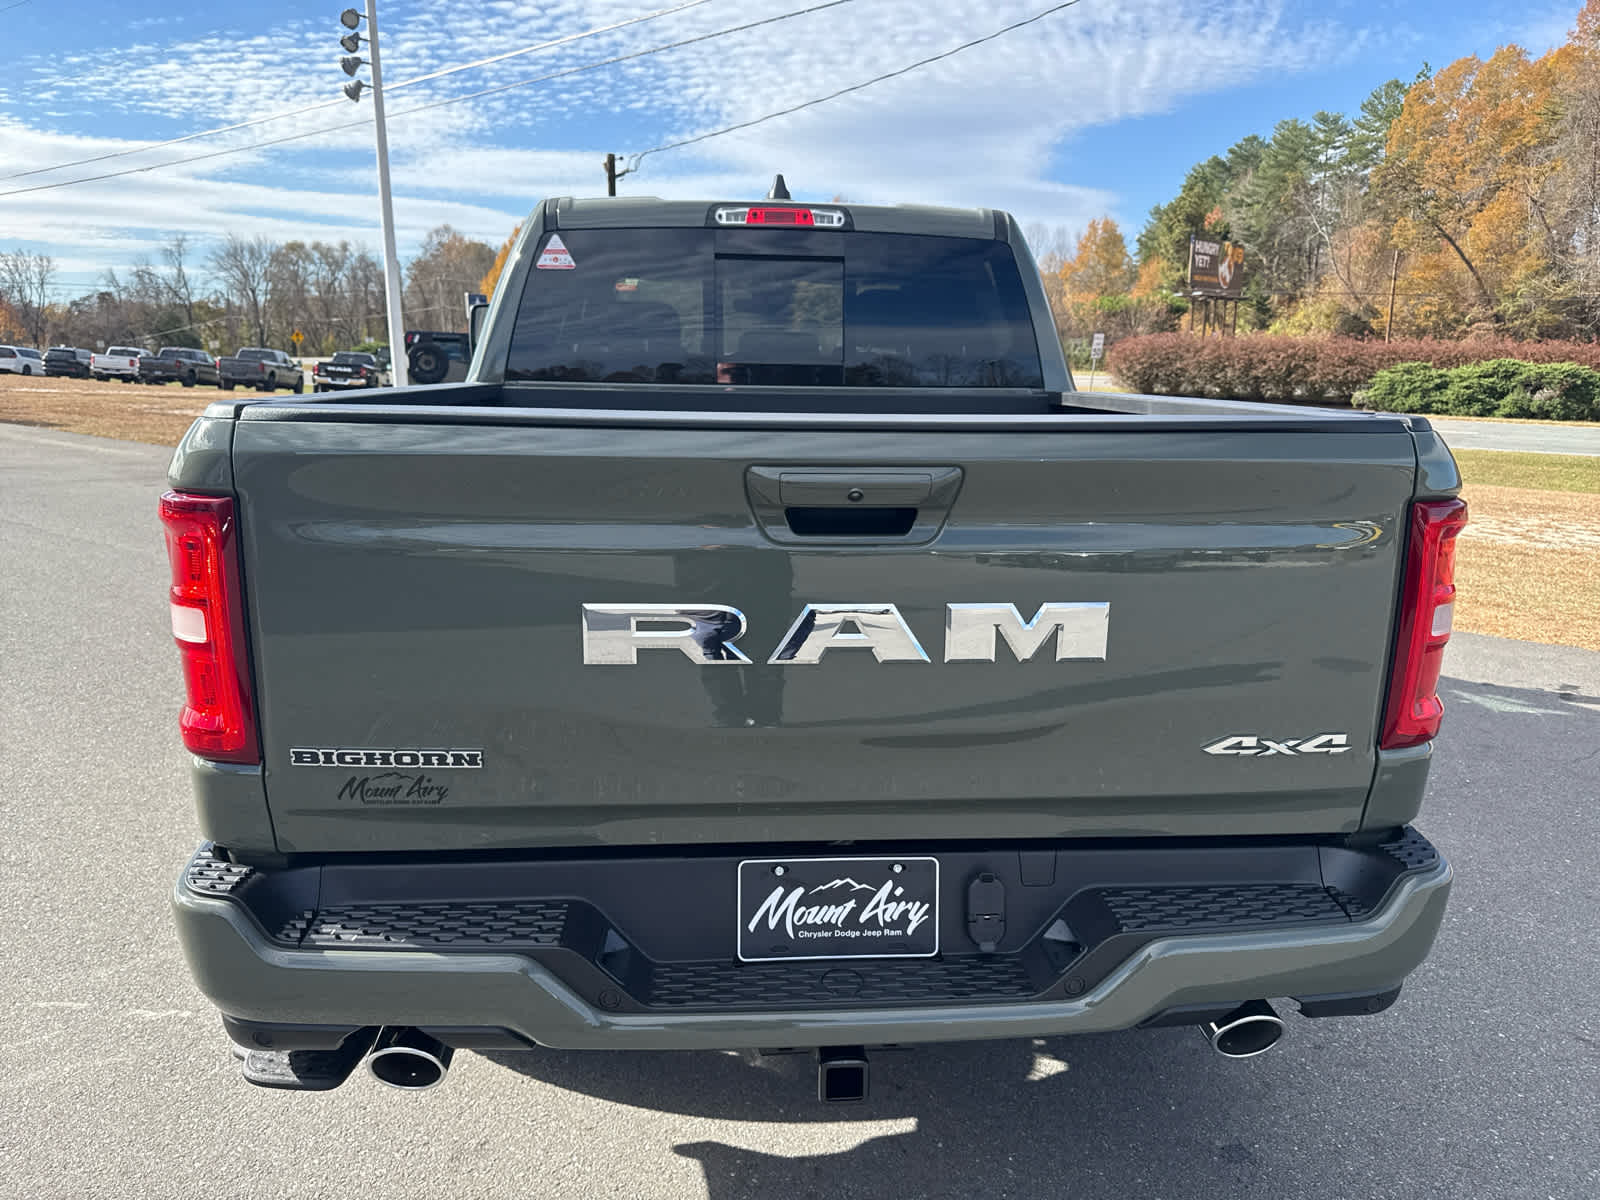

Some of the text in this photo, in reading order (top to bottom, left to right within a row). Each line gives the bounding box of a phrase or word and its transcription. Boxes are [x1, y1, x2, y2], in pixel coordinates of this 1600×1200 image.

[581, 602, 1110, 665] RAM
[290, 748, 484, 769] BIGHORN
[337, 775, 449, 804] Mount Airy
[747, 879, 930, 940] Mount Airy
[798, 928, 903, 939] Chrysler Dodge Jeep Ram
